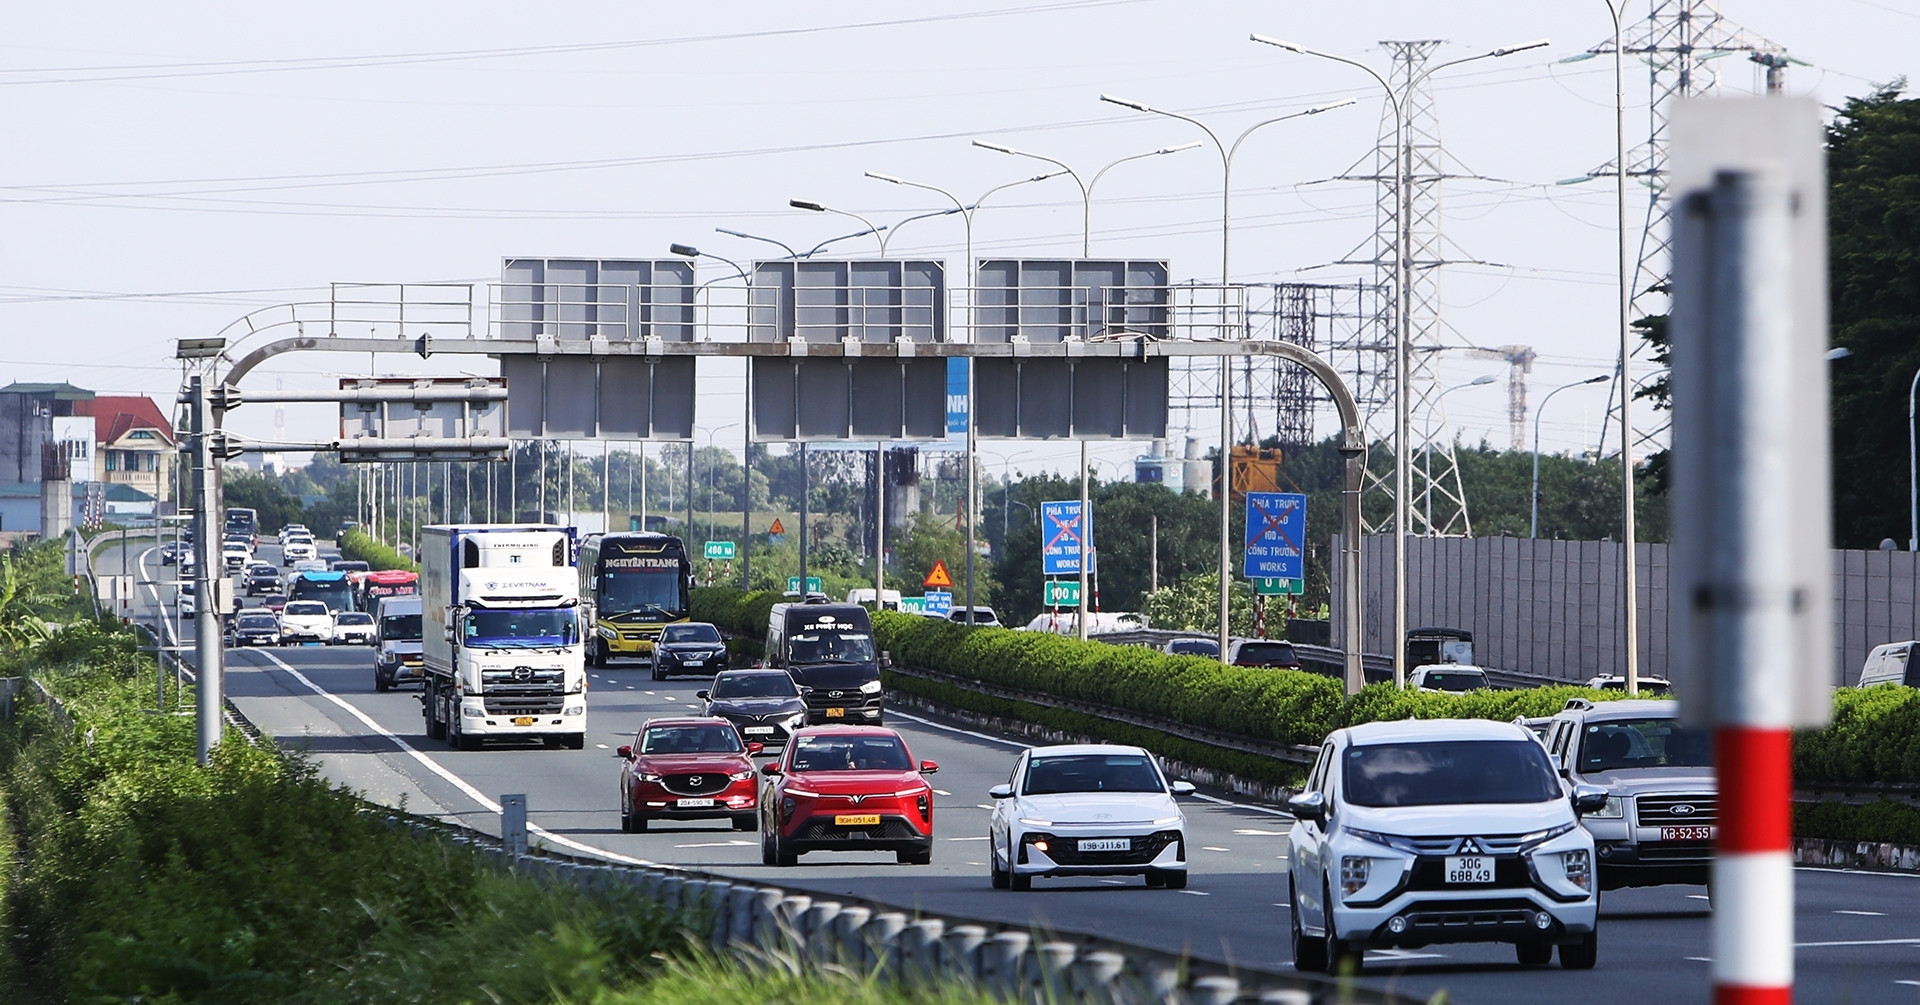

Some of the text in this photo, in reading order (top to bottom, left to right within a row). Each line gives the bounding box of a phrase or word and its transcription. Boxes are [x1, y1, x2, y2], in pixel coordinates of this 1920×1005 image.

[1046, 504, 1062, 515] PHÍA
[1264, 531, 1277, 541] 100
[707, 545, 722, 555] 400
[1247, 543, 1267, 556] CÔNG
[646, 558, 679, 568] TRANG
[1056, 560, 1080, 569] WORKS
[1259, 562, 1287, 572] WORKS
[1050, 588, 1069, 600] 100
[837, 623, 854, 631] HỌC
[1662, 827, 1709, 840] KB-52-55
[1459, 858, 1481, 869] 30G
[1450, 870, 1490, 882] 688.49
